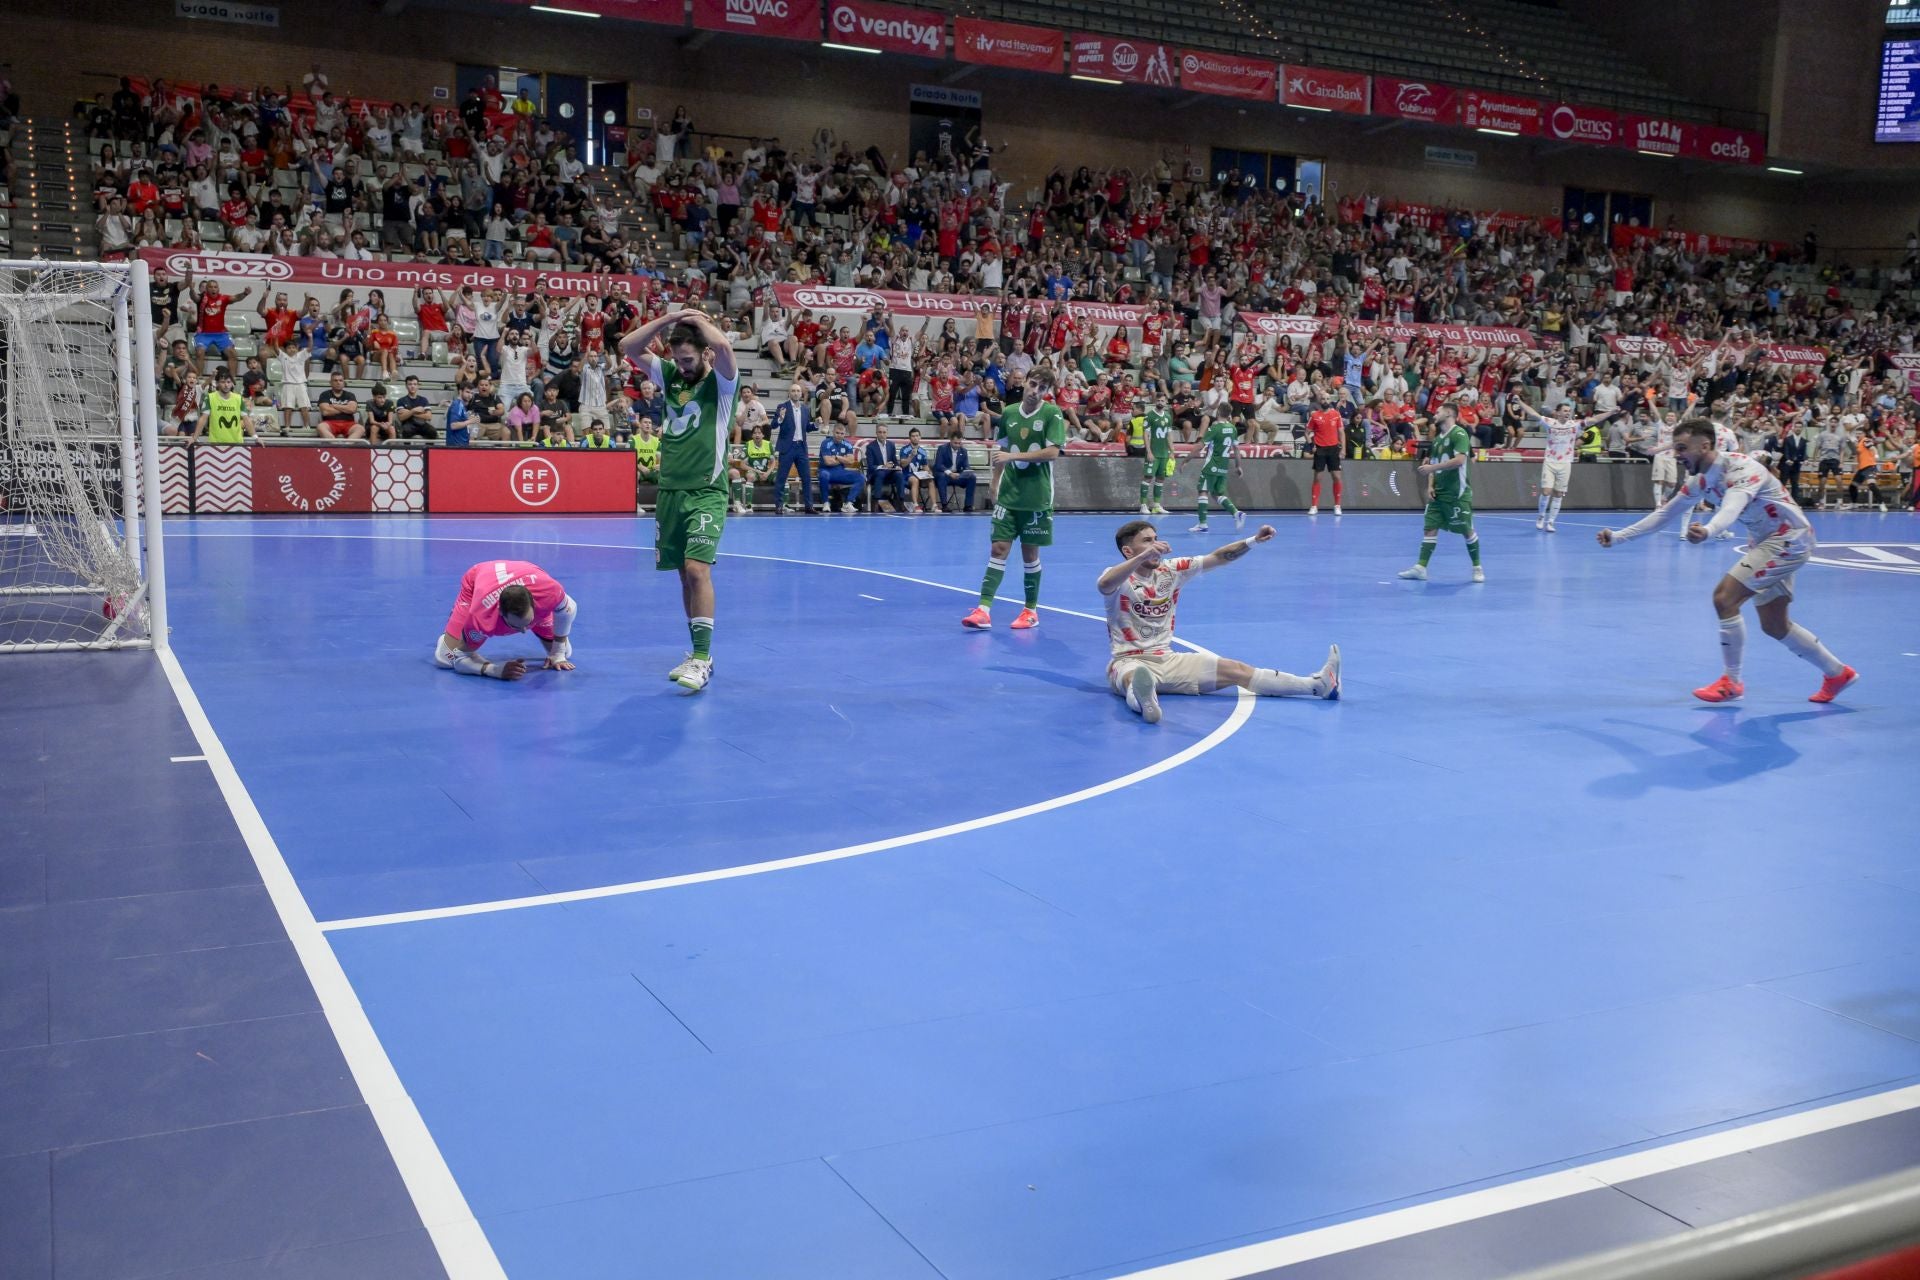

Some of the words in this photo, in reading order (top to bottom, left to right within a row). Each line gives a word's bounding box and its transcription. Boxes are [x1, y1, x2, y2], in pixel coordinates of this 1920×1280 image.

[726, 0, 788, 17] NOVAC
[976, 34, 994, 51] itv
[1112, 53, 1138, 66] SALUD
[1200, 60, 1231, 73] Aditivos
[1233, 65, 1245, 75] del
[1247, 66, 1274, 79] Sureste
[1306, 79, 1362, 101] CaixaBank
[1480, 99, 1537, 116] Ayuntamiento
[1480, 117, 1490, 126] de
[1492, 117, 1521, 130] Murcia
[1637, 121, 1682, 143] UCAM
[321, 262, 385, 281] Uno
[397, 269, 453, 284] más
[463, 272, 496, 287] de
[906, 293, 954, 310] Uno
[1464, 327, 1521, 343] familia
[1782, 346, 1826, 362] familia
[279, 475, 309, 511] SUELA
[315, 451, 347, 511] CARAMELO
